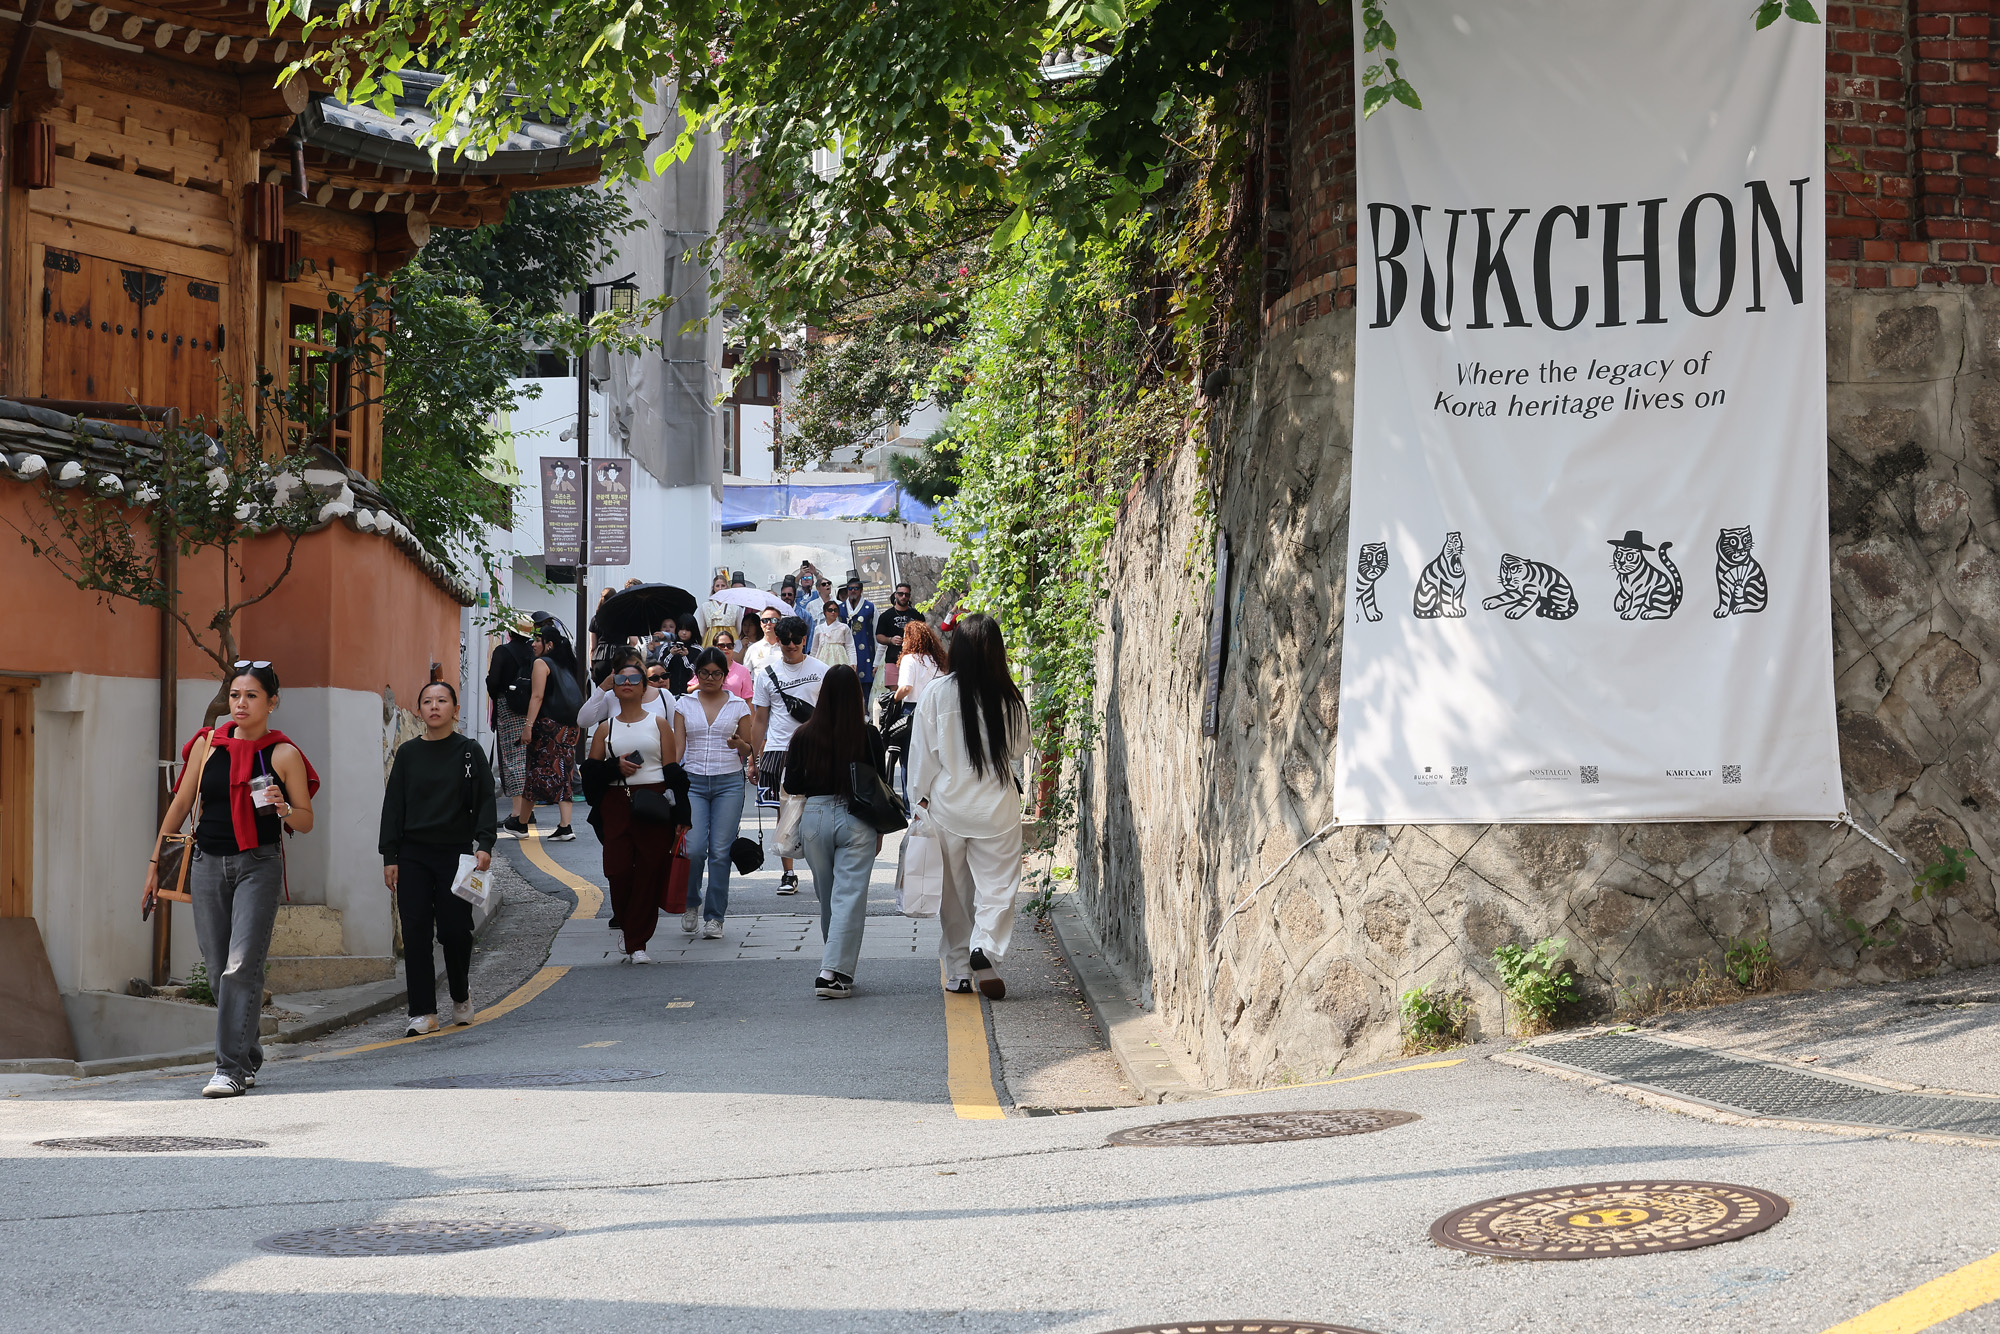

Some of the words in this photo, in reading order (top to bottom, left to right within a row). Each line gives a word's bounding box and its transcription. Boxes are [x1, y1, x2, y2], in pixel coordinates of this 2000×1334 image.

[1367, 177, 1810, 332] BUKCHON
[1457, 361, 1529, 386] Where
[1539, 359, 1578, 384] the
[1587, 359, 1675, 386] legacy
[1683, 350, 1713, 375] of
[1433, 391, 1497, 417] Korea
[1507, 393, 1615, 420] heritage
[1624, 386, 1685, 411] lives
[1694, 389, 1726, 409] on
